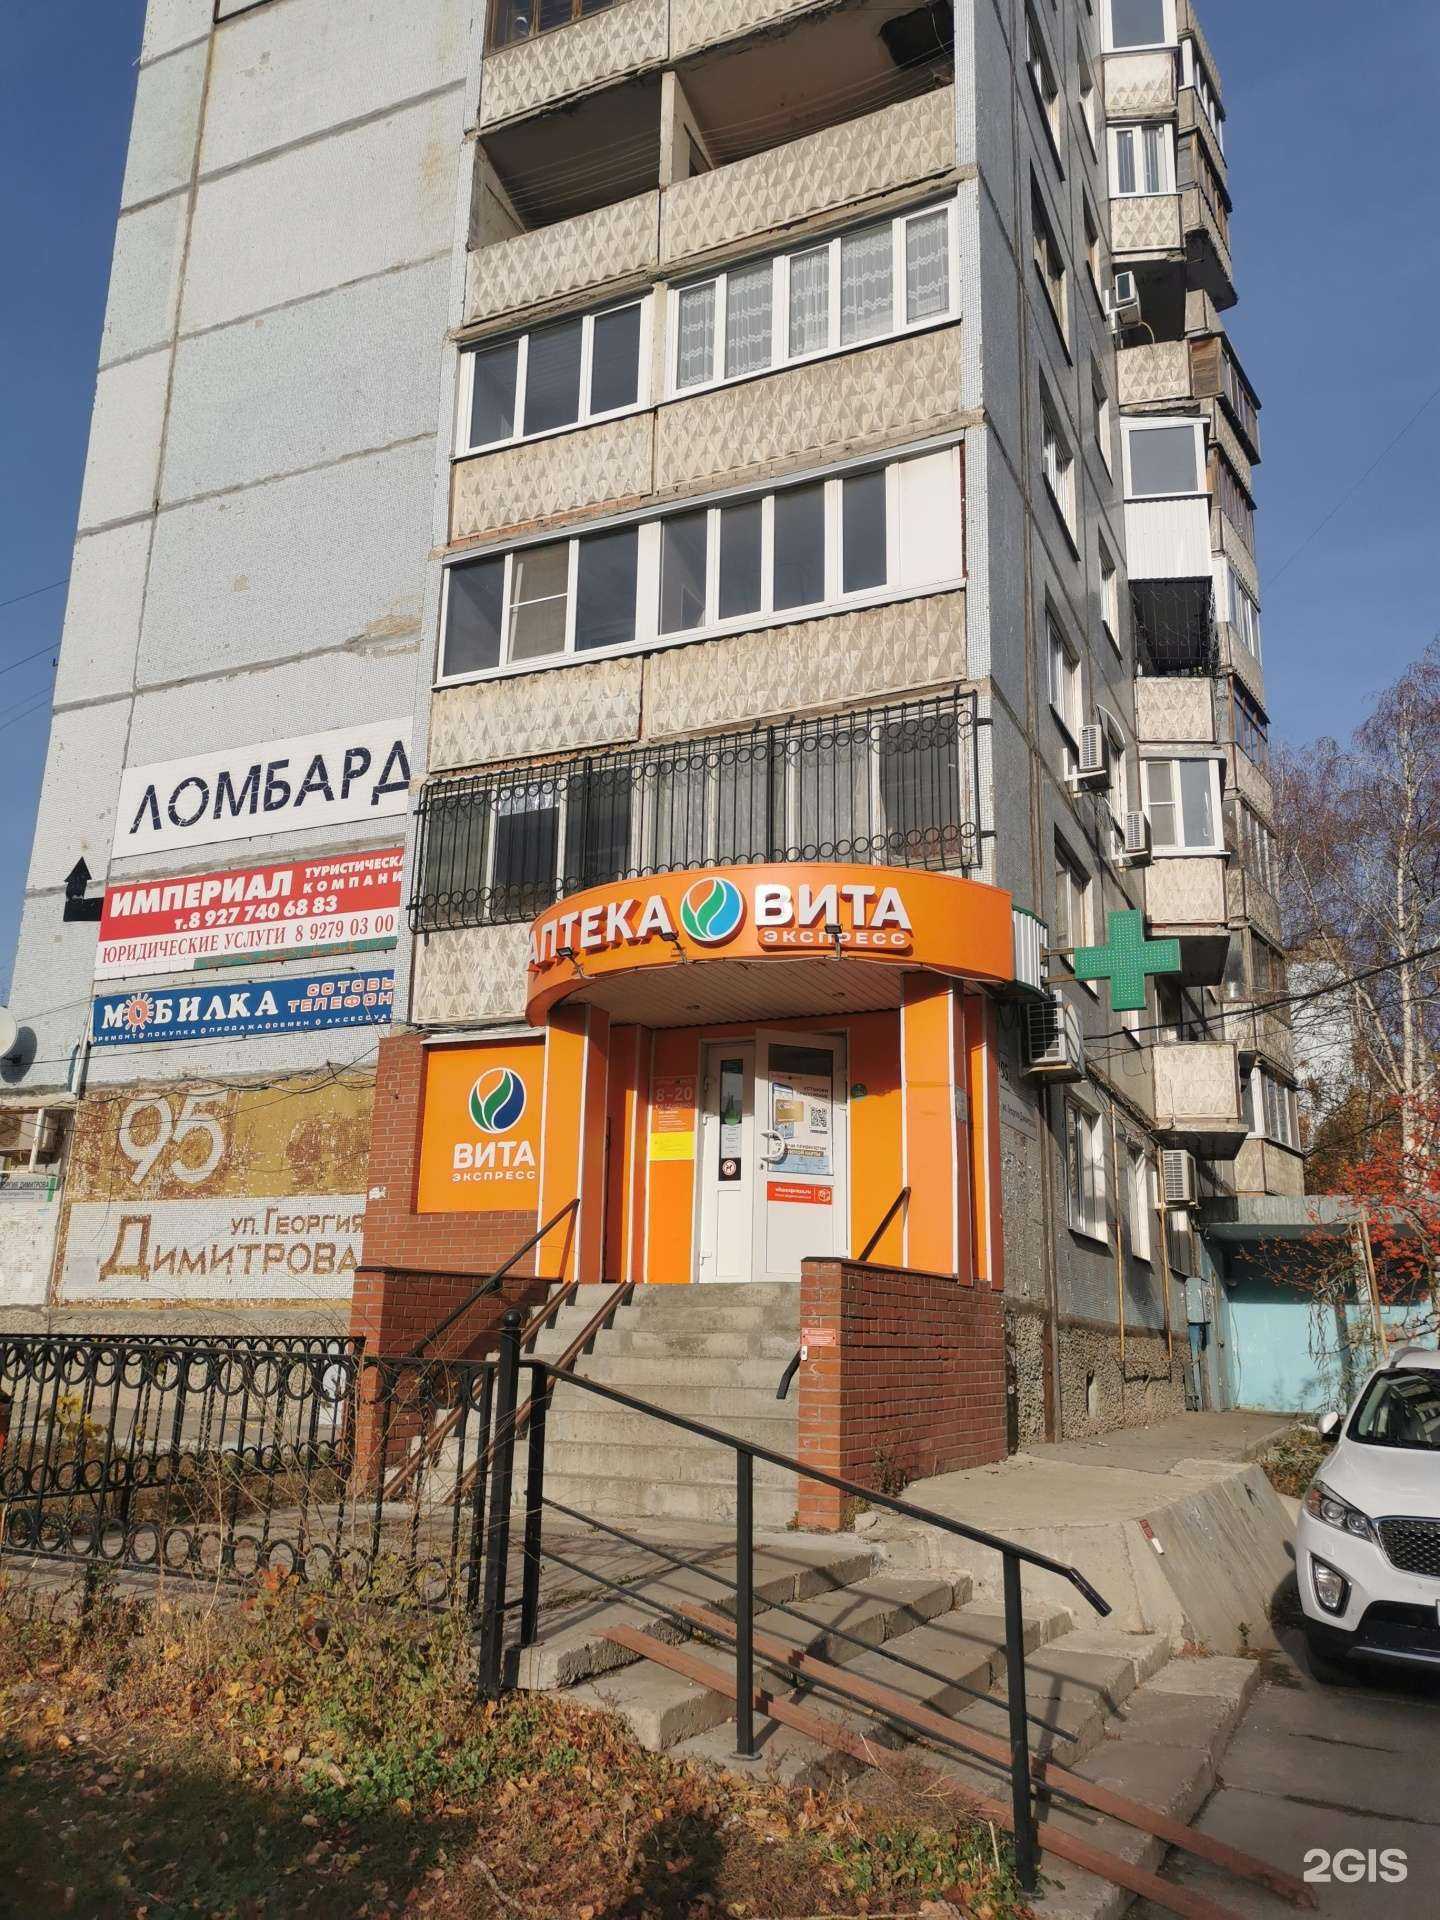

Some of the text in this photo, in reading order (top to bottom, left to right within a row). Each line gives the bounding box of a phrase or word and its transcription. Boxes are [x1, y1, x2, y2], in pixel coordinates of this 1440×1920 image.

[129, 740, 410, 834] ЛОМБАРД
[110, 870, 293, 918] ИМПЕРИАЛ
[205, 907, 241, 927] 927
[244, 902, 280, 921] 740
[283, 898, 309, 917] 68
[312, 895, 338, 914] 83
[755, 884, 912, 930] ВИТА
[102, 914, 394, 963] ЮРИДИЧЕСКИЕ УСЛУГИ 8 9279 03 00
[764, 930, 906, 945] ЭКСПРЕСС
[101, 990, 278, 1030] МОБИЛКА
[119, 1088, 228, 1185] 95
[453, 1140, 536, 1169] ВИТА
[452, 1170, 536, 1182] ЭКСПРЕСС
